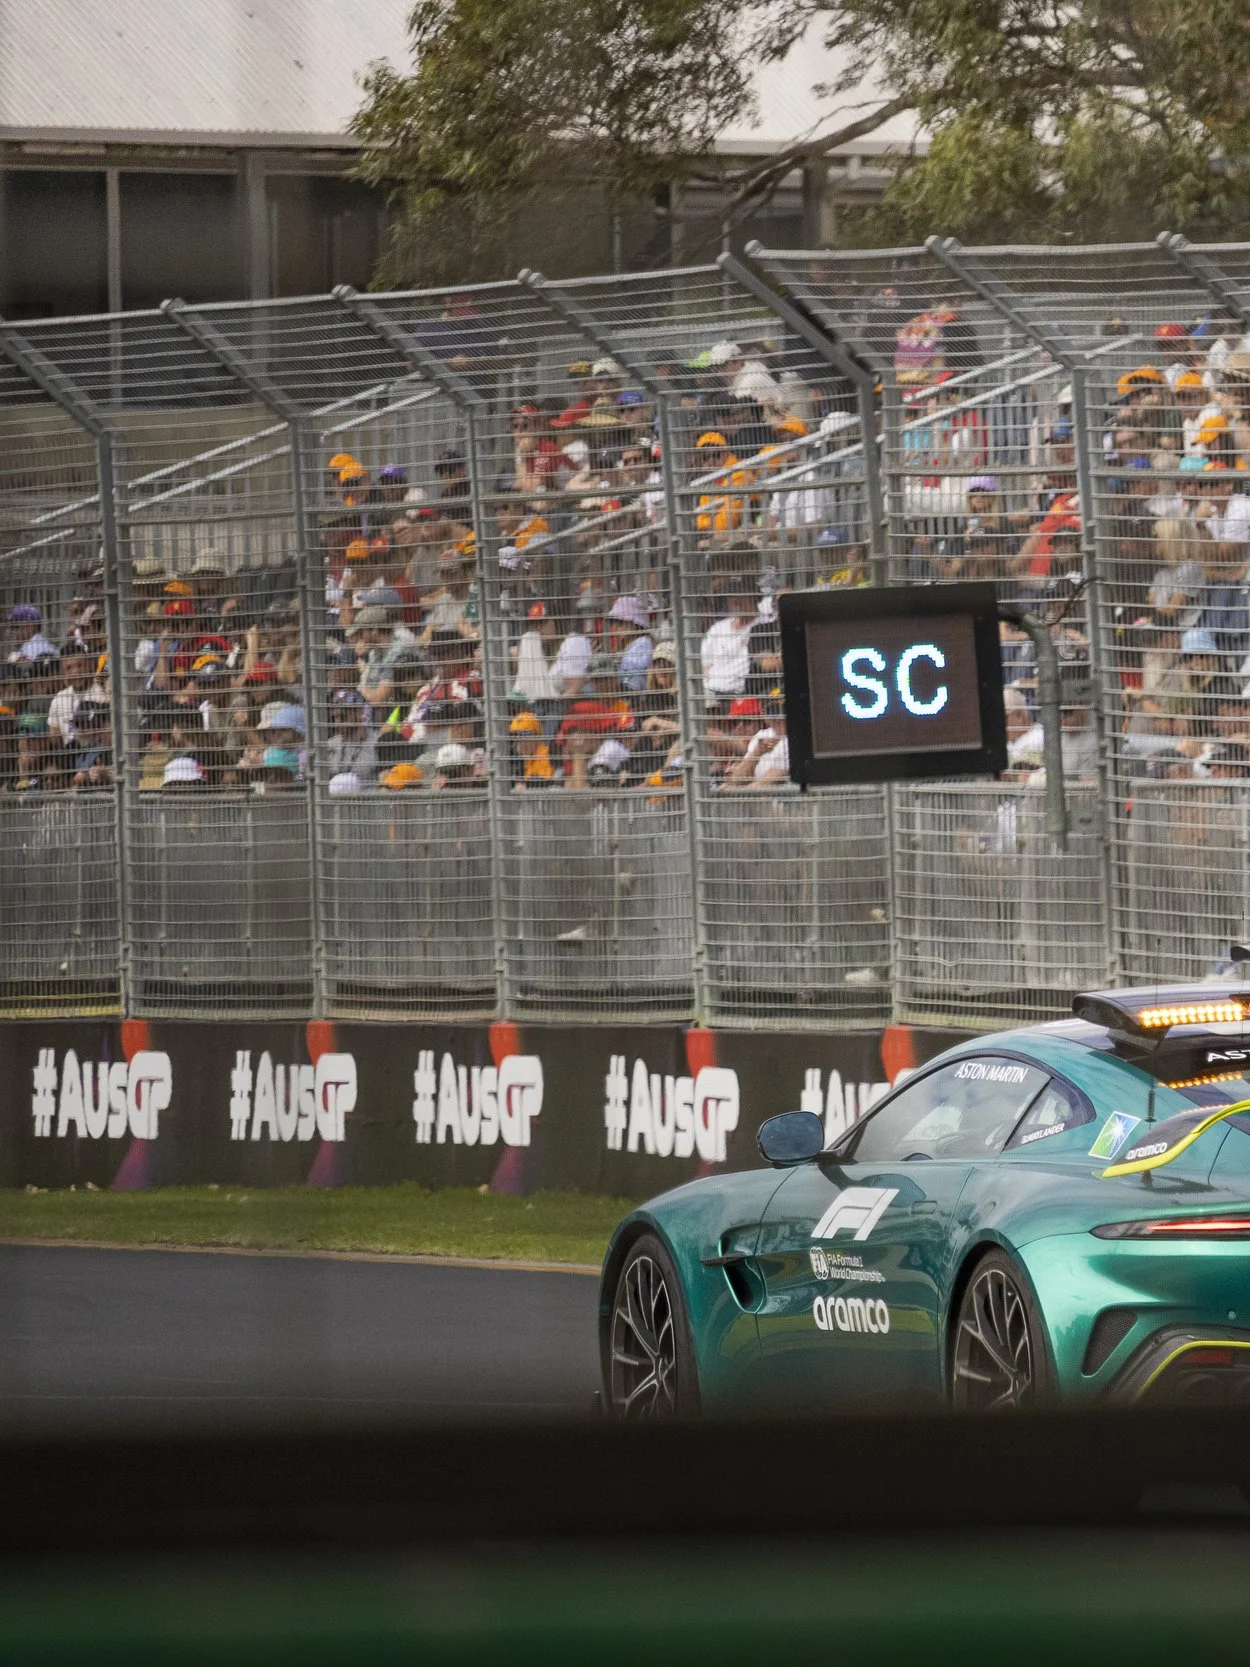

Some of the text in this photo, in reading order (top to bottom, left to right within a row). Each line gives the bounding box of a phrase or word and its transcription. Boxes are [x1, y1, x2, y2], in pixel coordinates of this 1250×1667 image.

[841, 644, 948, 719] SC
[954, 1062, 1029, 1084] ASTON MARTIN
[1125, 1142, 1168, 1160] aramco
[830, 1267, 846, 1279] World
[813, 1296, 890, 1334] aramco
